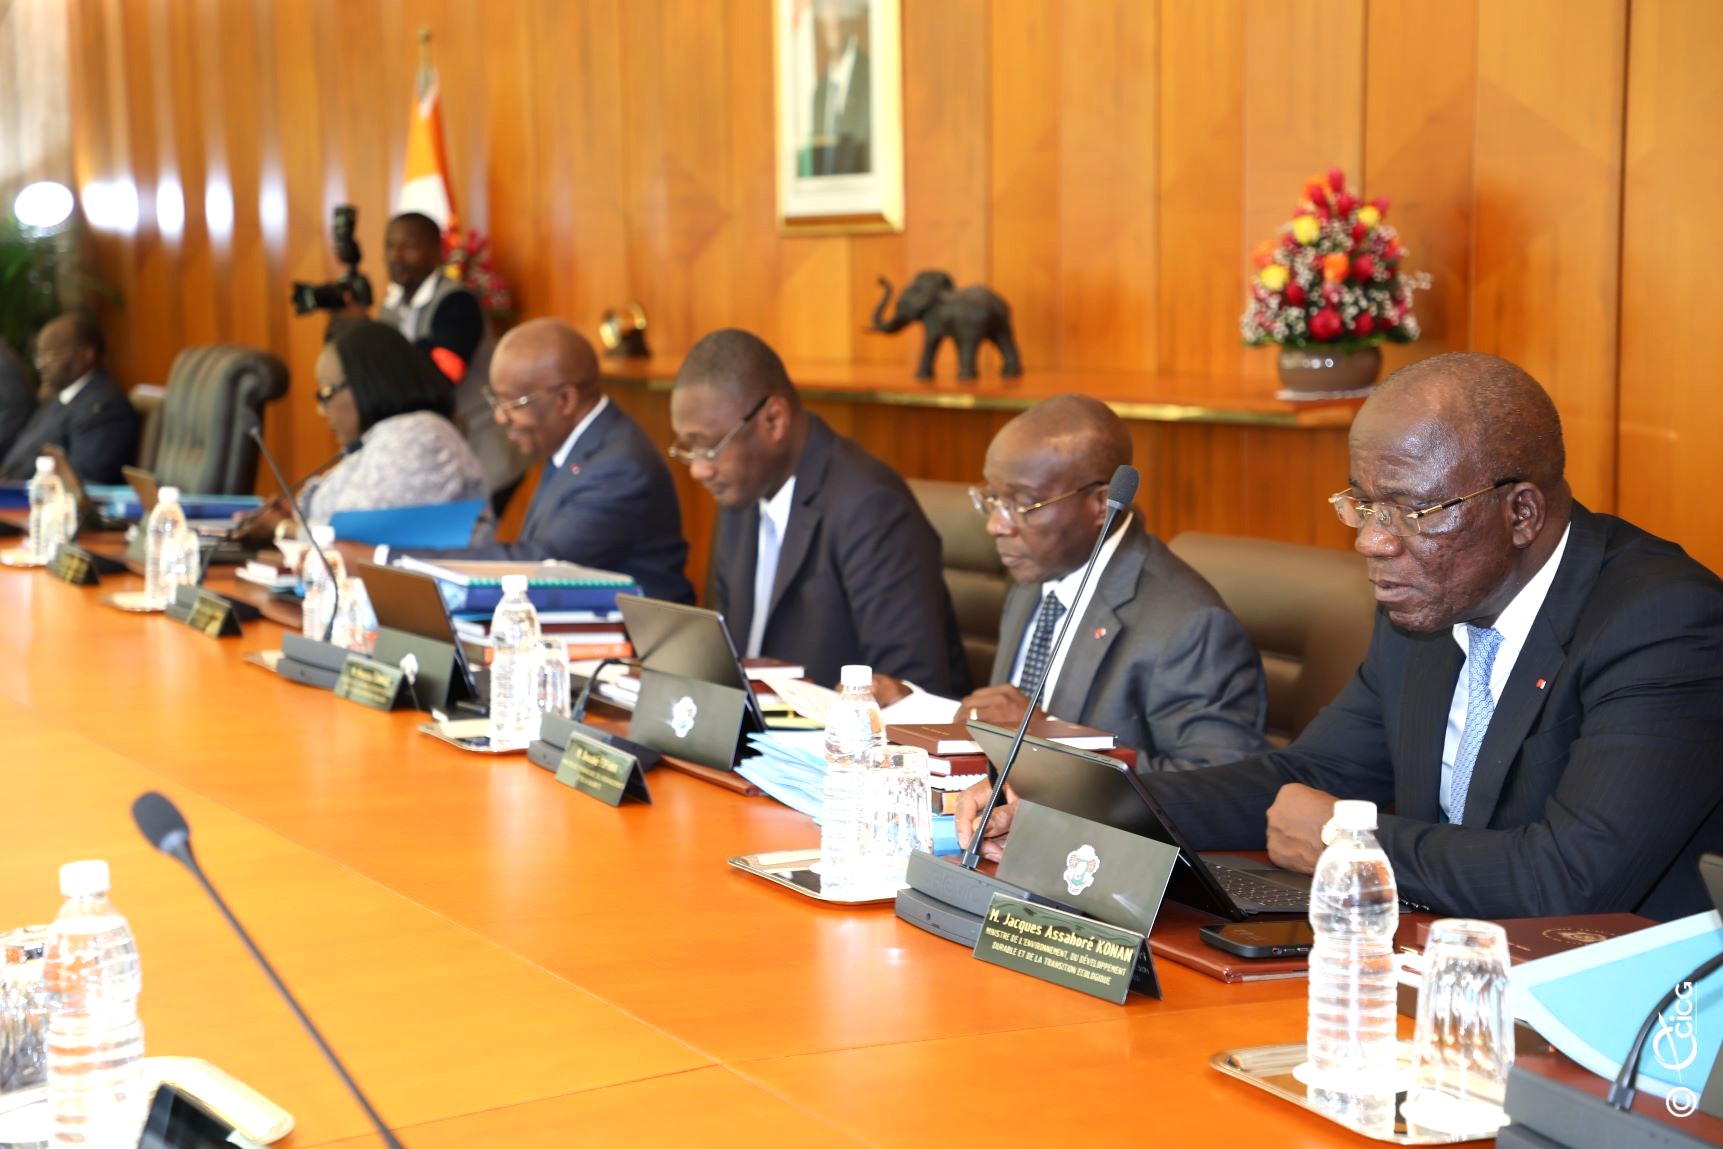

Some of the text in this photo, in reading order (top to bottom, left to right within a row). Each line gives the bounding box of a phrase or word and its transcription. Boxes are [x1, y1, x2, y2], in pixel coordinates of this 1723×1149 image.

[985, 927, 1010, 941] MINISTRE
[1010, 934, 1019, 943] DE
[1069, 952, 1079, 961] DU
[989, 908, 1134, 962] M. Jacques Assahoré KONAN
[992, 941, 1018, 956] DURABLE
[1017, 949, 1026, 958] ET
[1025, 952, 1034, 960] DE
[1034, 955, 1042, 963] LA
[1044, 957, 1077, 974] TRANSITION
